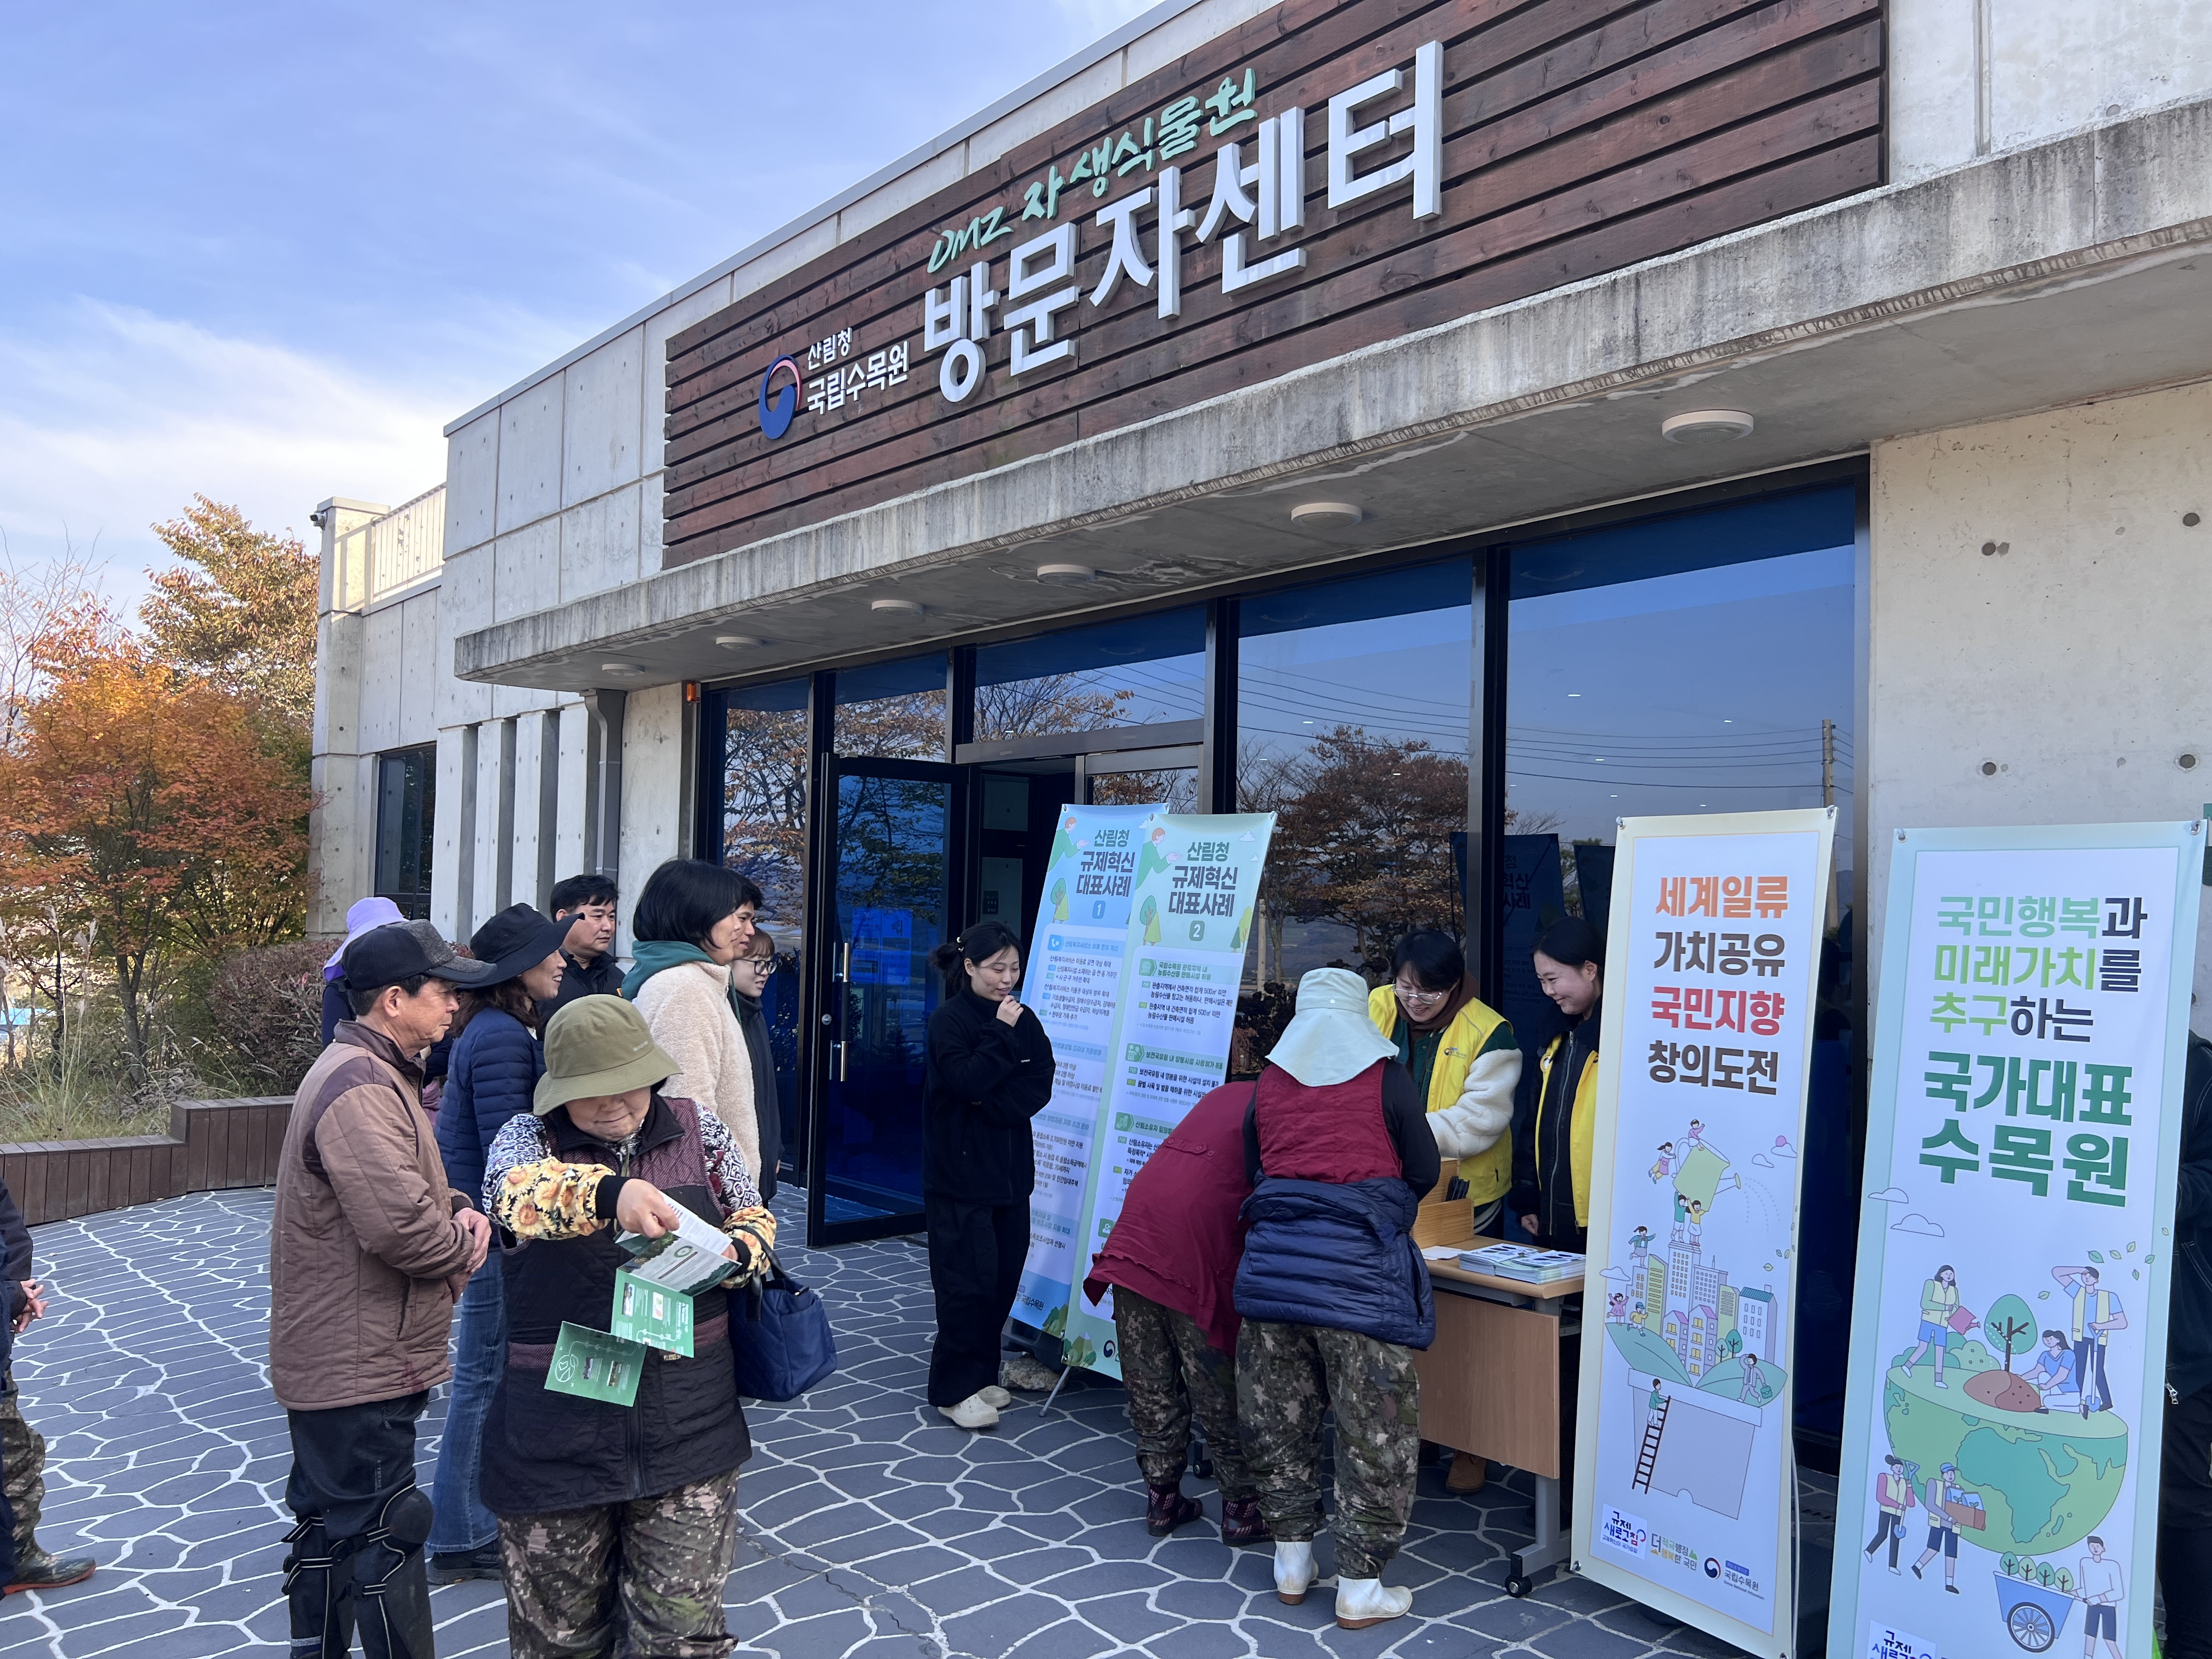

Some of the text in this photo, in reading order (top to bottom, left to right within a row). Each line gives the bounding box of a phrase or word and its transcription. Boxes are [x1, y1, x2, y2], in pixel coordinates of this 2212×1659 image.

[927, 67, 1257, 274] DMZ 자생식물원
[923, 40, 1444, 405] 방문자센터
[807, 327, 854, 370] 산림청
[807, 340, 910, 415] 국립수목원
[1094, 830, 1130, 847] 산림청
[1081, 851, 1135, 873] 규제혁신
[1187, 842, 1229, 862] 산림청
[1076, 874, 1132, 898] 대표사례
[1172, 866, 1238, 890] 규제혁신
[1097, 903, 1102, 916] 1
[1168, 891, 1235, 917] 대표사례
[1655, 876, 1788, 918] 세계일류
[1937, 895, 2148, 940] 국민행복과
[1193, 923, 1201, 938] 2
[1654, 931, 1786, 977] 가치공유
[1934, 944, 2142, 993] 미래가치를
[1651, 986, 1785, 1036] 국민지향
[1929, 991, 2094, 1042] 추구하는
[1647, 1039, 1779, 1096] 창의도전
[1923, 1051, 2133, 1126] 국가대표
[1918, 1118, 2129, 1207] 수목원
[1021, 1295, 1045, 1311] 국립수목원
[1612, 1510, 1632, 1530] 규제
[1604, 1522, 1638, 1546] 새로고침
[1651, 1533, 1689, 1556] 더 적극행정
[1661, 1548, 1697, 1571] 행복한 국민
[1724, 1569, 1759, 1592] 국립수목원
[1883, 1630, 1912, 1654] 규제
